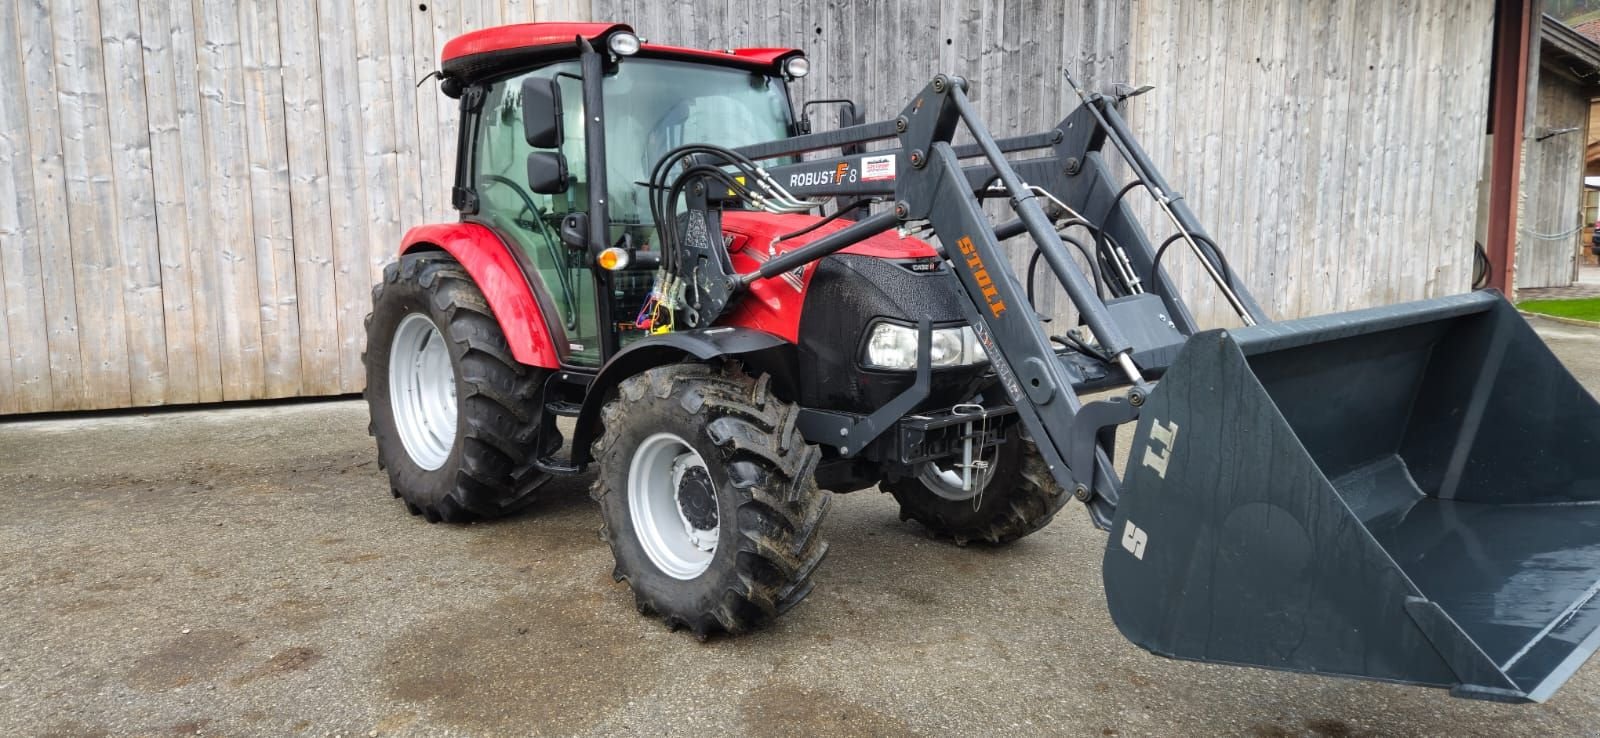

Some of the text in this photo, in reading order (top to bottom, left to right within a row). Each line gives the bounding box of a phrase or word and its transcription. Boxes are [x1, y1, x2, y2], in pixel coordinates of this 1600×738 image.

[790, 170, 836, 187] ROBUST
[849, 169, 857, 183] 8
[955, 234, 1007, 320] STOLL
